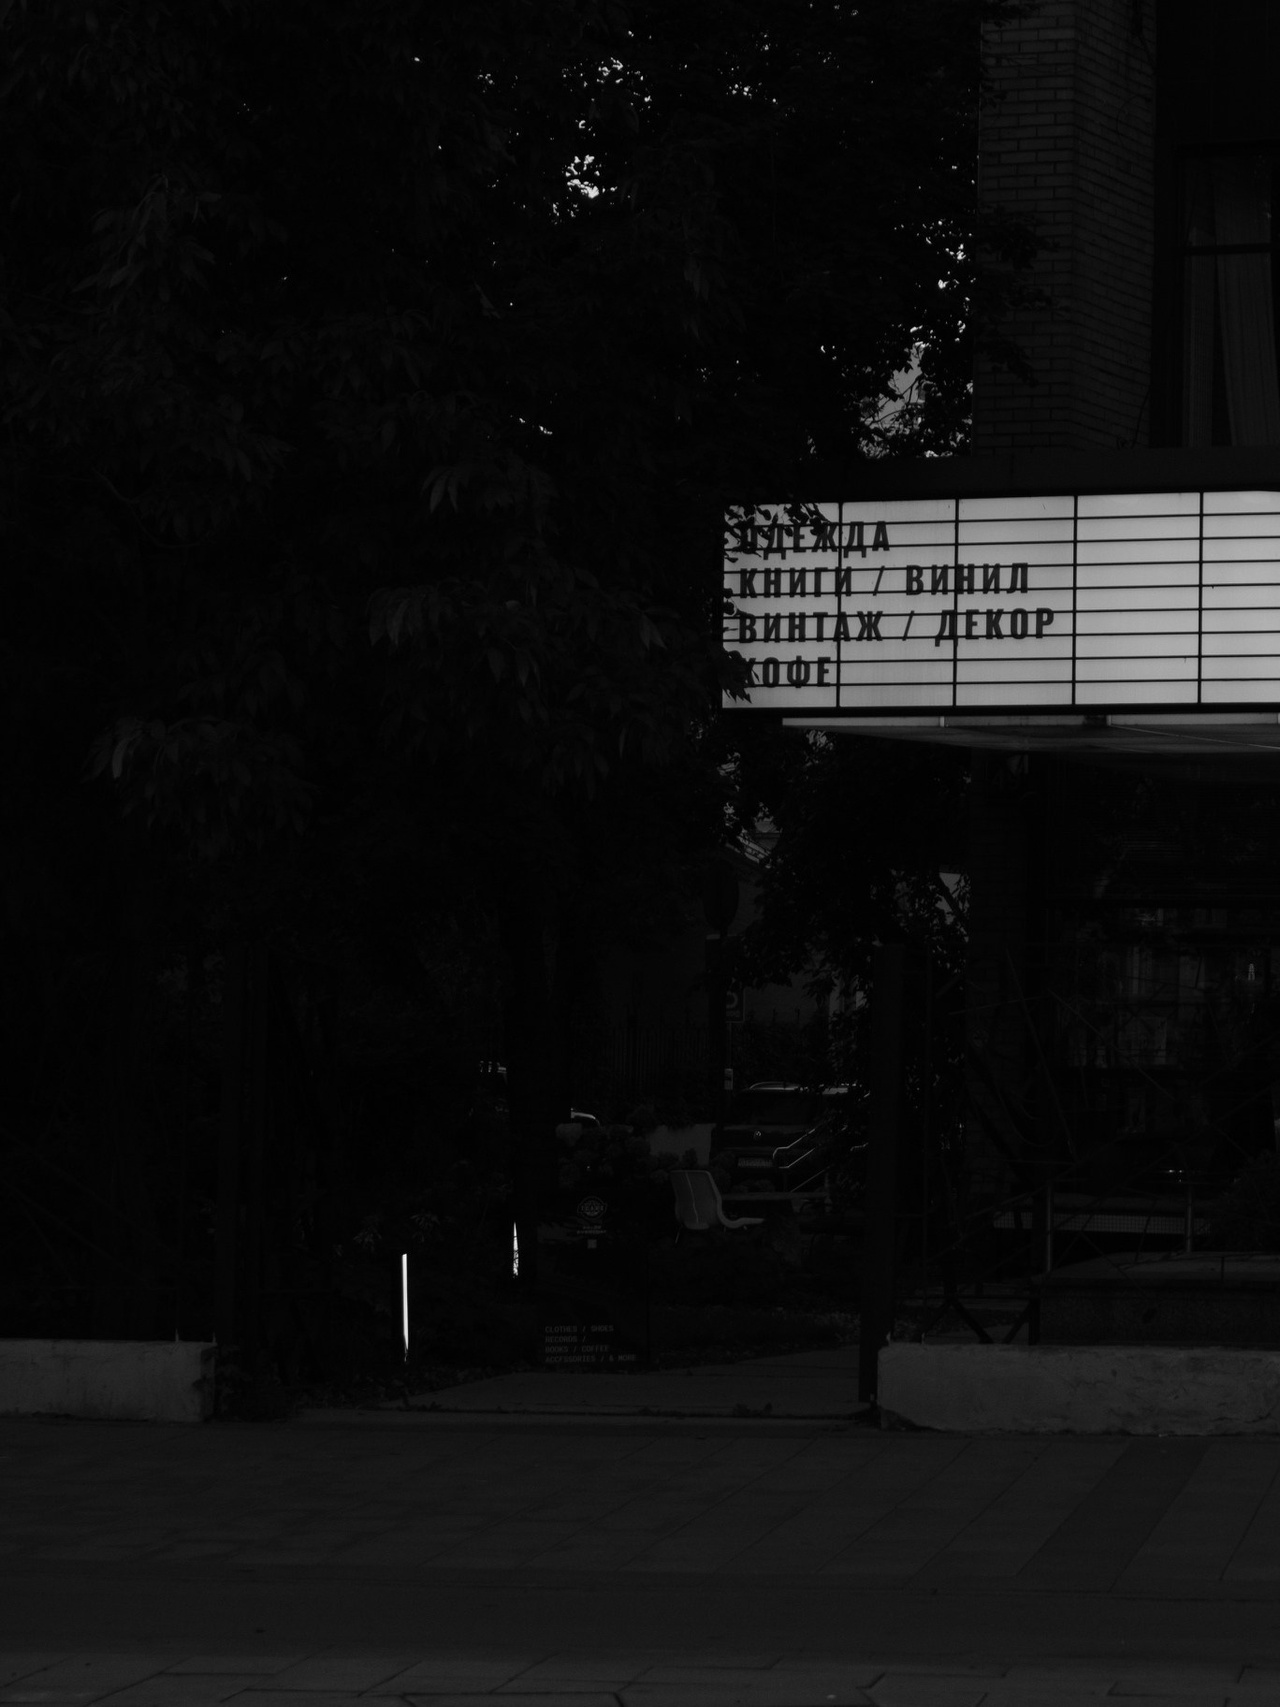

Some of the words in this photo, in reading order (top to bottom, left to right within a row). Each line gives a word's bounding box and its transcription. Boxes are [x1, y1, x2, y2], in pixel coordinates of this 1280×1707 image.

[740, 566, 853, 599] КНИГИ
[905, 563, 1029, 596] ВИНИЛ
[738, 610, 884, 644] ВИНТАЖ
[934, 607, 1056, 648] ДЕКОР
